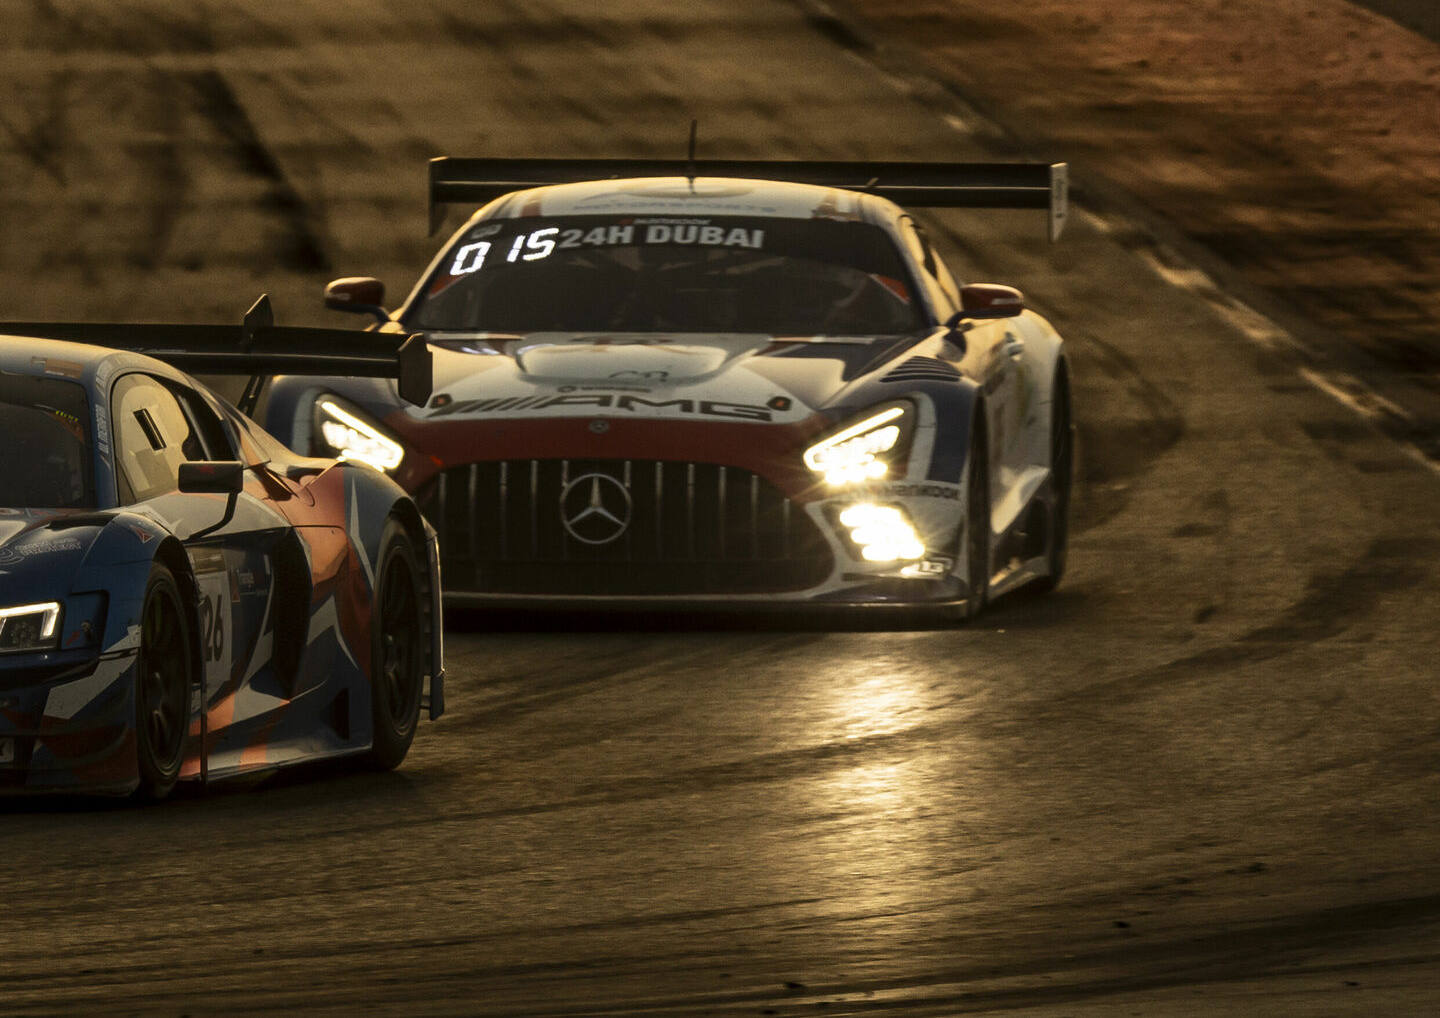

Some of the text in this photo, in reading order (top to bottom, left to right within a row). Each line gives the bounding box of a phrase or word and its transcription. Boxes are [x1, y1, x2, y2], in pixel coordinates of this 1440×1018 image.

[558, 225, 765, 249] 24H DUBAI
[532, 395, 774, 422] AMG
[200, 594, 224, 662] 26
